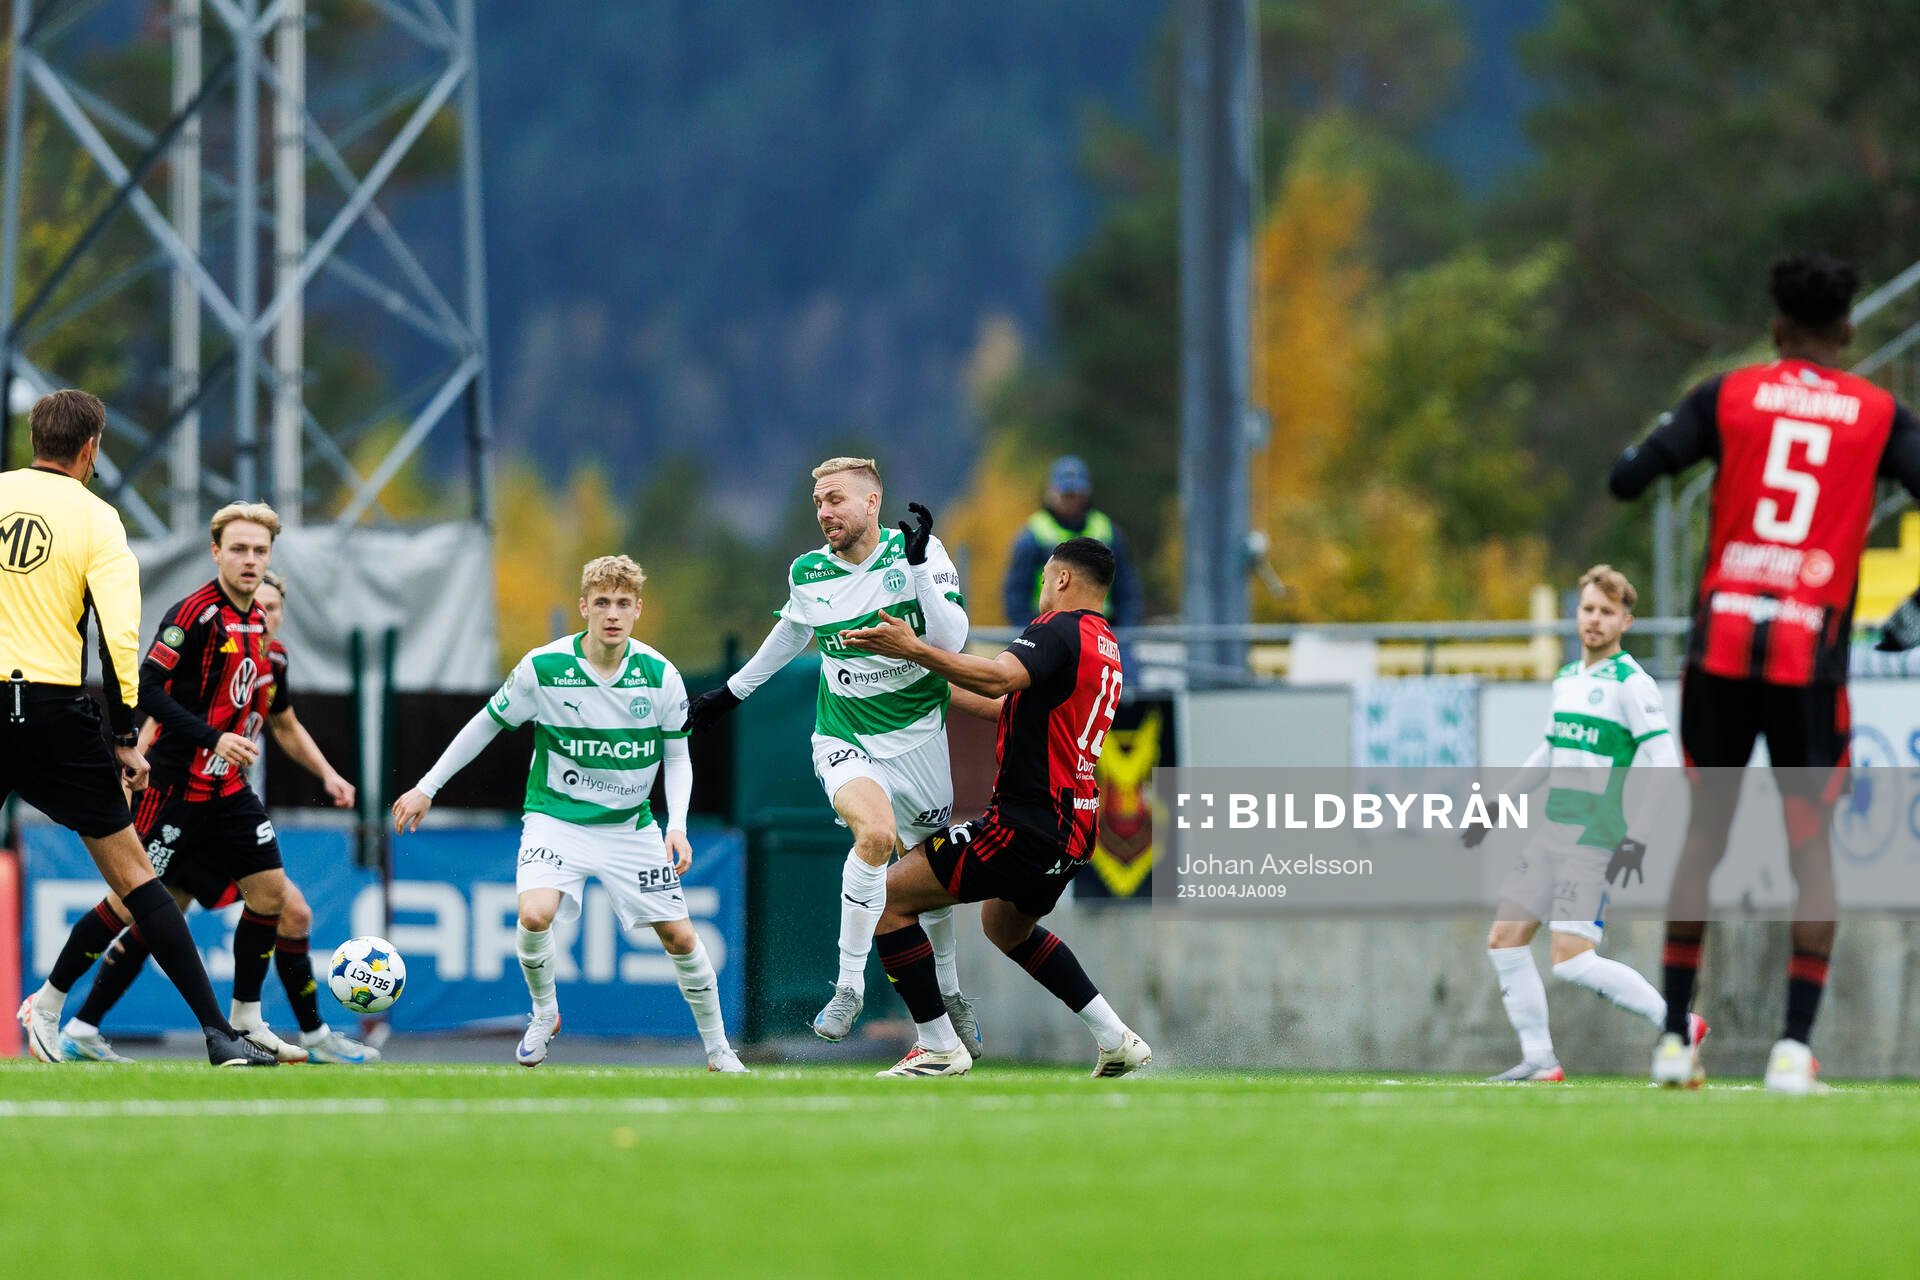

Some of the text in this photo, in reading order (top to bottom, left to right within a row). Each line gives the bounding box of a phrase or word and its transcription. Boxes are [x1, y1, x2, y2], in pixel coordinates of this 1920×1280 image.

[1753, 416, 1832, 545] 5
[804, 568, 836, 580] Telexia
[553, 677, 587, 686] Telexia
[623, 677, 648, 686] Telex
[853, 659, 920, 685] Hygientek
[559, 739, 656, 759] HITACHI
[350, 967, 391, 991] SELECT
